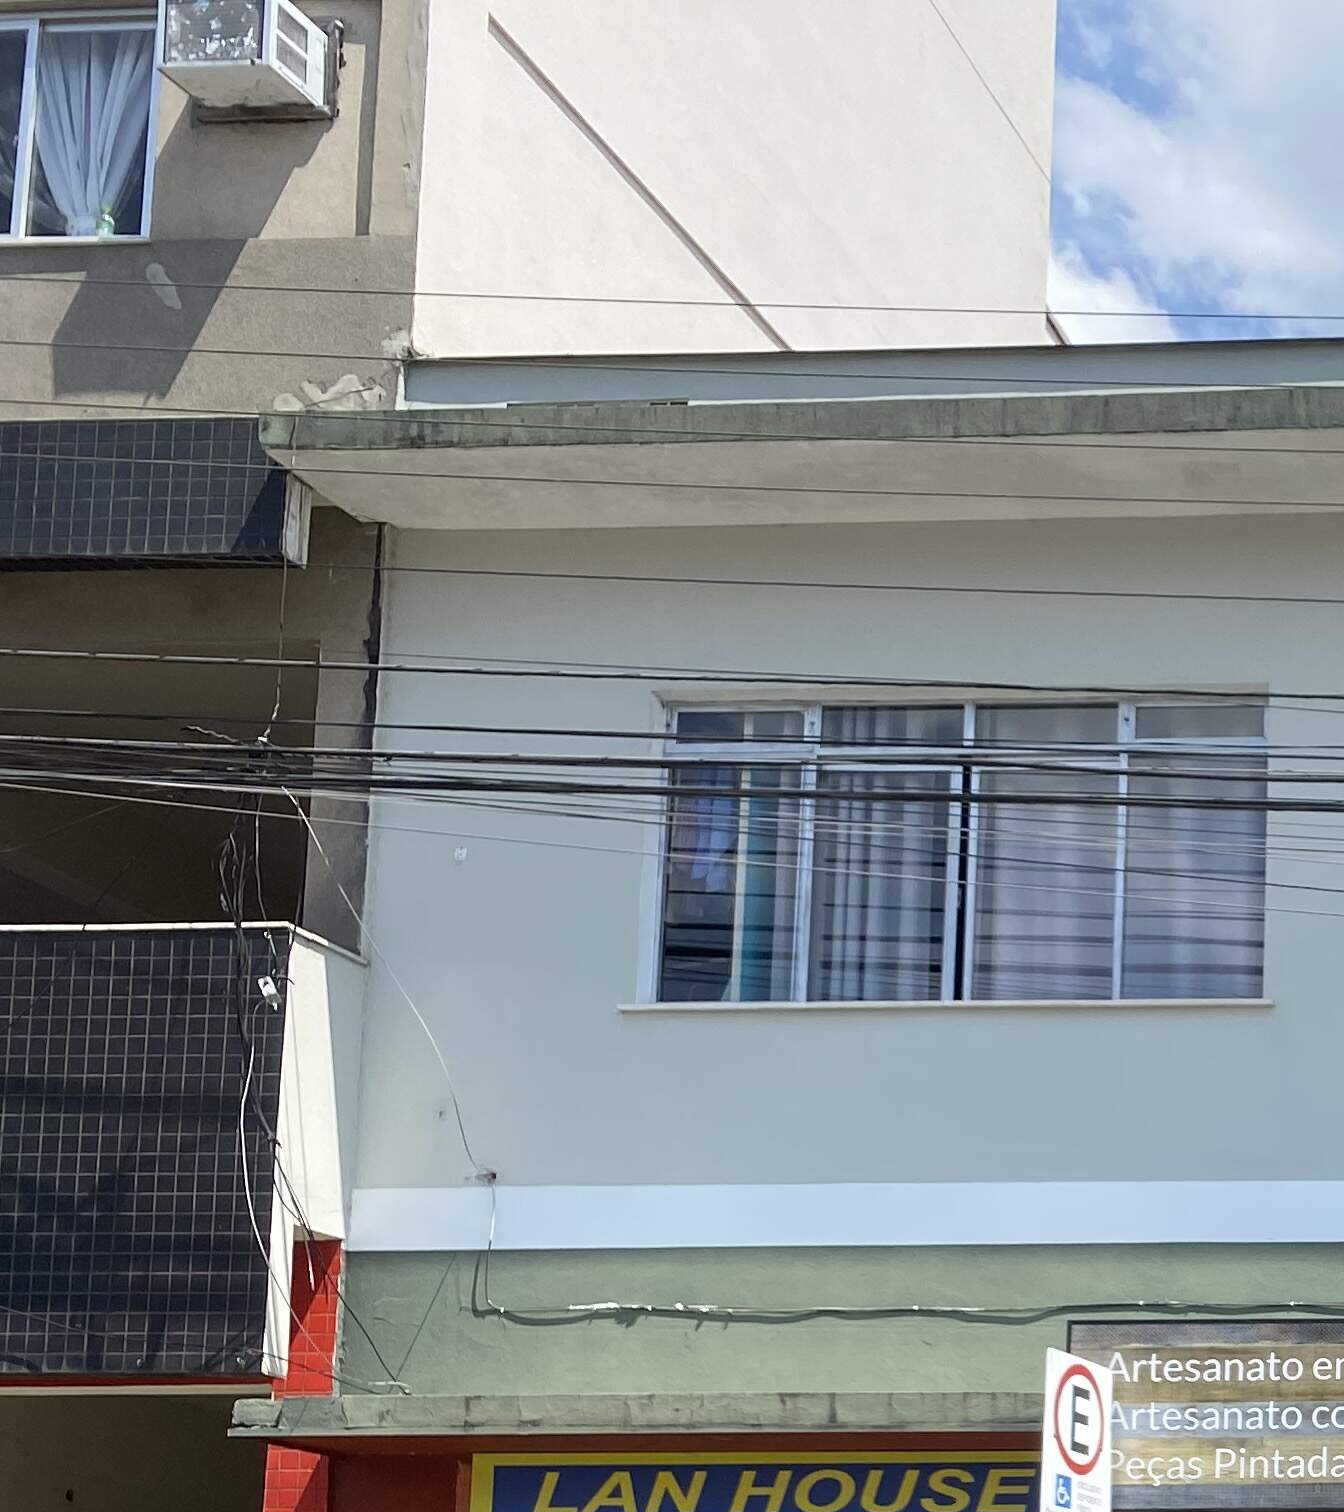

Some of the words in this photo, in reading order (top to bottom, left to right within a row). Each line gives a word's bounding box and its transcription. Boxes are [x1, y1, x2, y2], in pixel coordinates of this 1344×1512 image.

[1108, 1351, 1304, 1383] Artesanato
[1071, 1384, 1090, 1456] E
[1110, 1400, 1303, 1431] Artesanato
